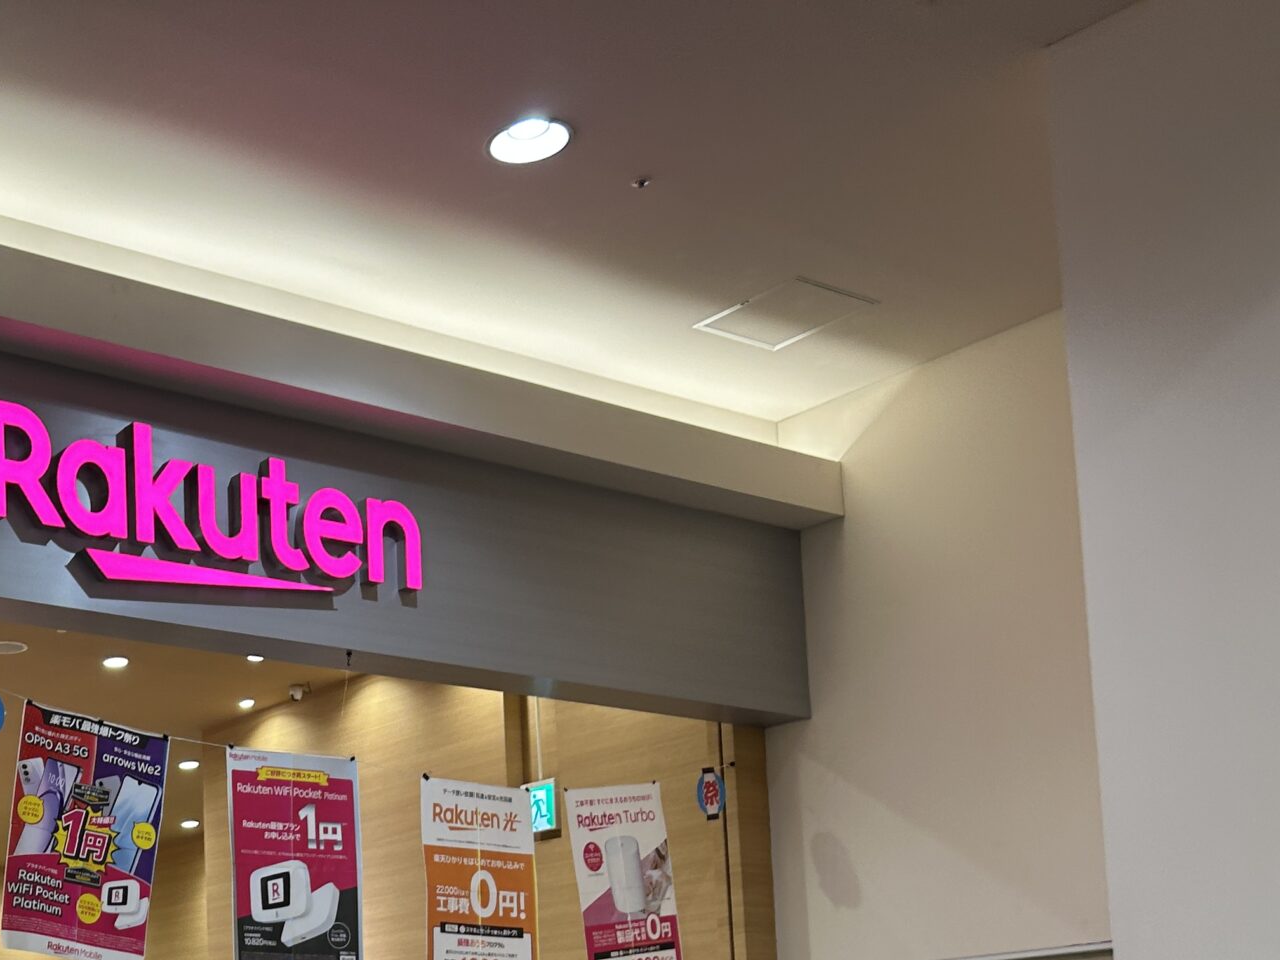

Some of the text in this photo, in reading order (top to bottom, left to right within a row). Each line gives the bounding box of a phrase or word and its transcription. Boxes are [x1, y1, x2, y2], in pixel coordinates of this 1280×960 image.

[25, 732, 53, 750] OPPO
[55, 742, 70, 754] A3
[73, 746, 88, 758] 5G
[103, 752, 136, 770] arrows
[138, 763, 161, 776] We2
[237, 783, 347, 800] Rakuten WiFi Pocket Platinum
[299, 804, 343, 850] 1円
[432, 803, 522, 831] Rakuten 光
[577, 808, 655, 831] Rakuten Turbo
[62, 809, 109, 862] 1円
[264, 832, 301, 840] お申し込みで
[18, 869, 62, 888] Rakuten
[8, 882, 70, 904] WiFi Pocket
[470, 870, 526, 919] 0円!
[13, 898, 61, 916] Platinum
[47, 941, 102, 960] Rakuten Mobile
